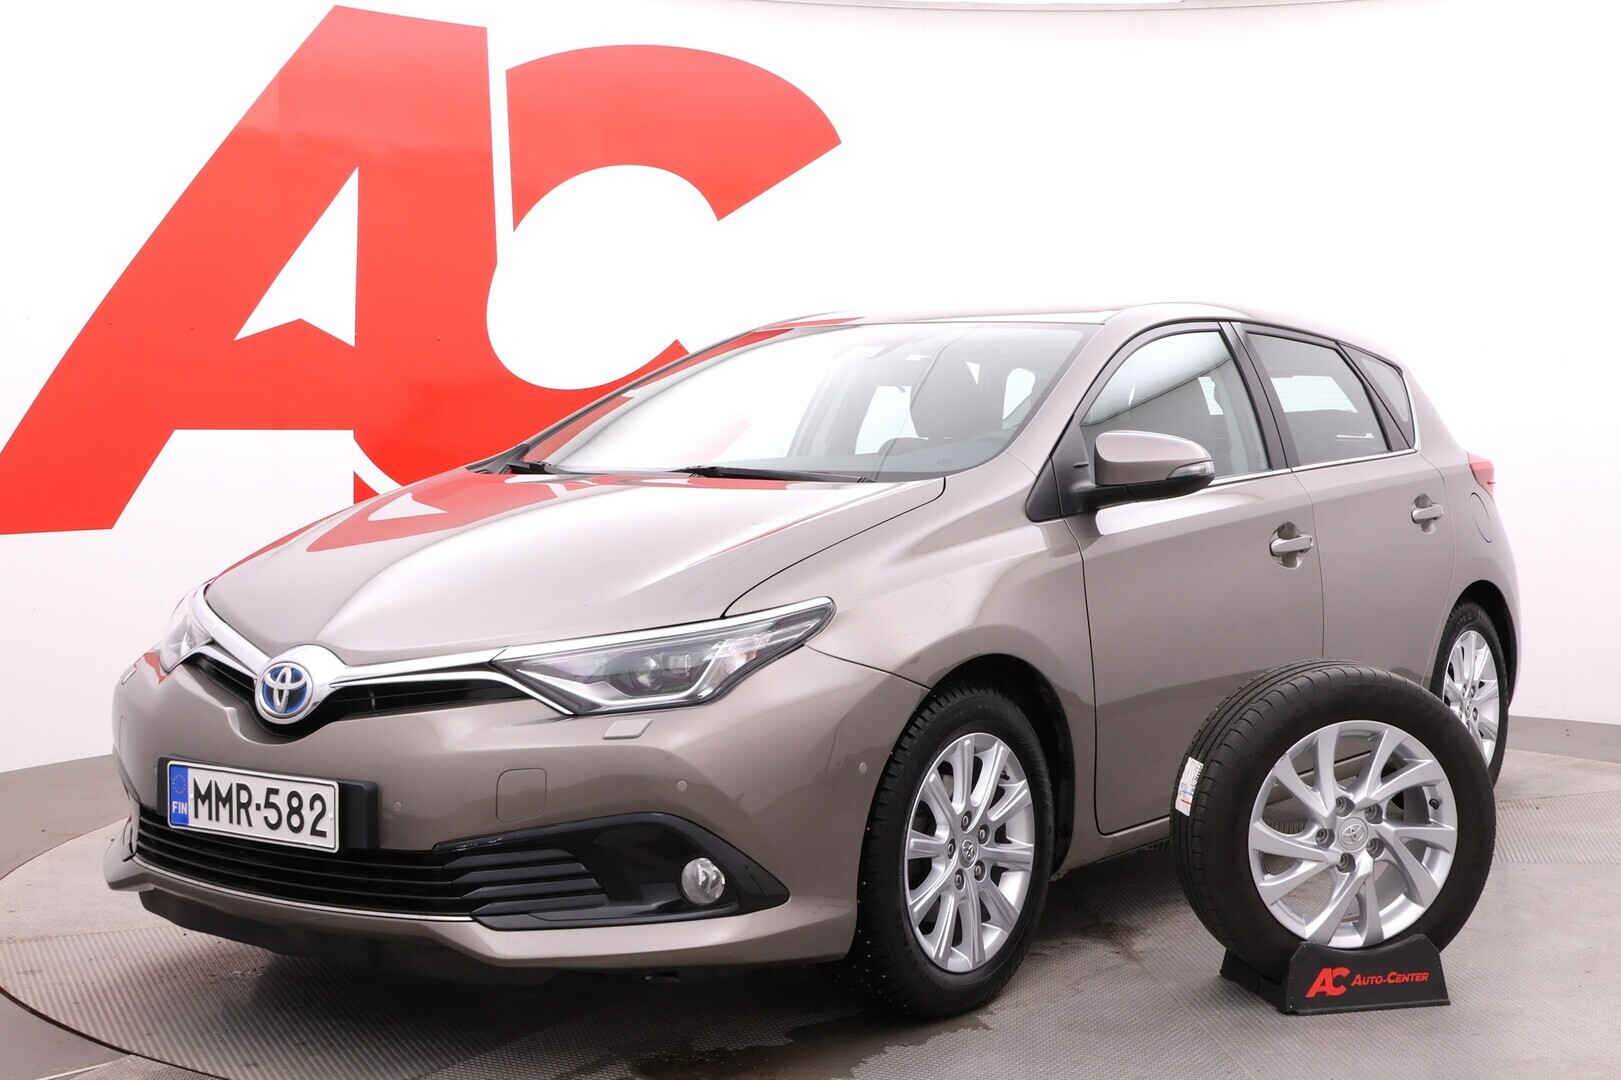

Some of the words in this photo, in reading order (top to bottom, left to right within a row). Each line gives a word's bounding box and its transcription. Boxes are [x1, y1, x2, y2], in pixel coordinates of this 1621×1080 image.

[0, 6, 841, 534] AC
[172, 801, 188, 815] FIN
[193, 777, 328, 839] MMR-582
[1305, 966, 1350, 998] AC
[1351, 971, 1430, 987] AUTO-CENTER
